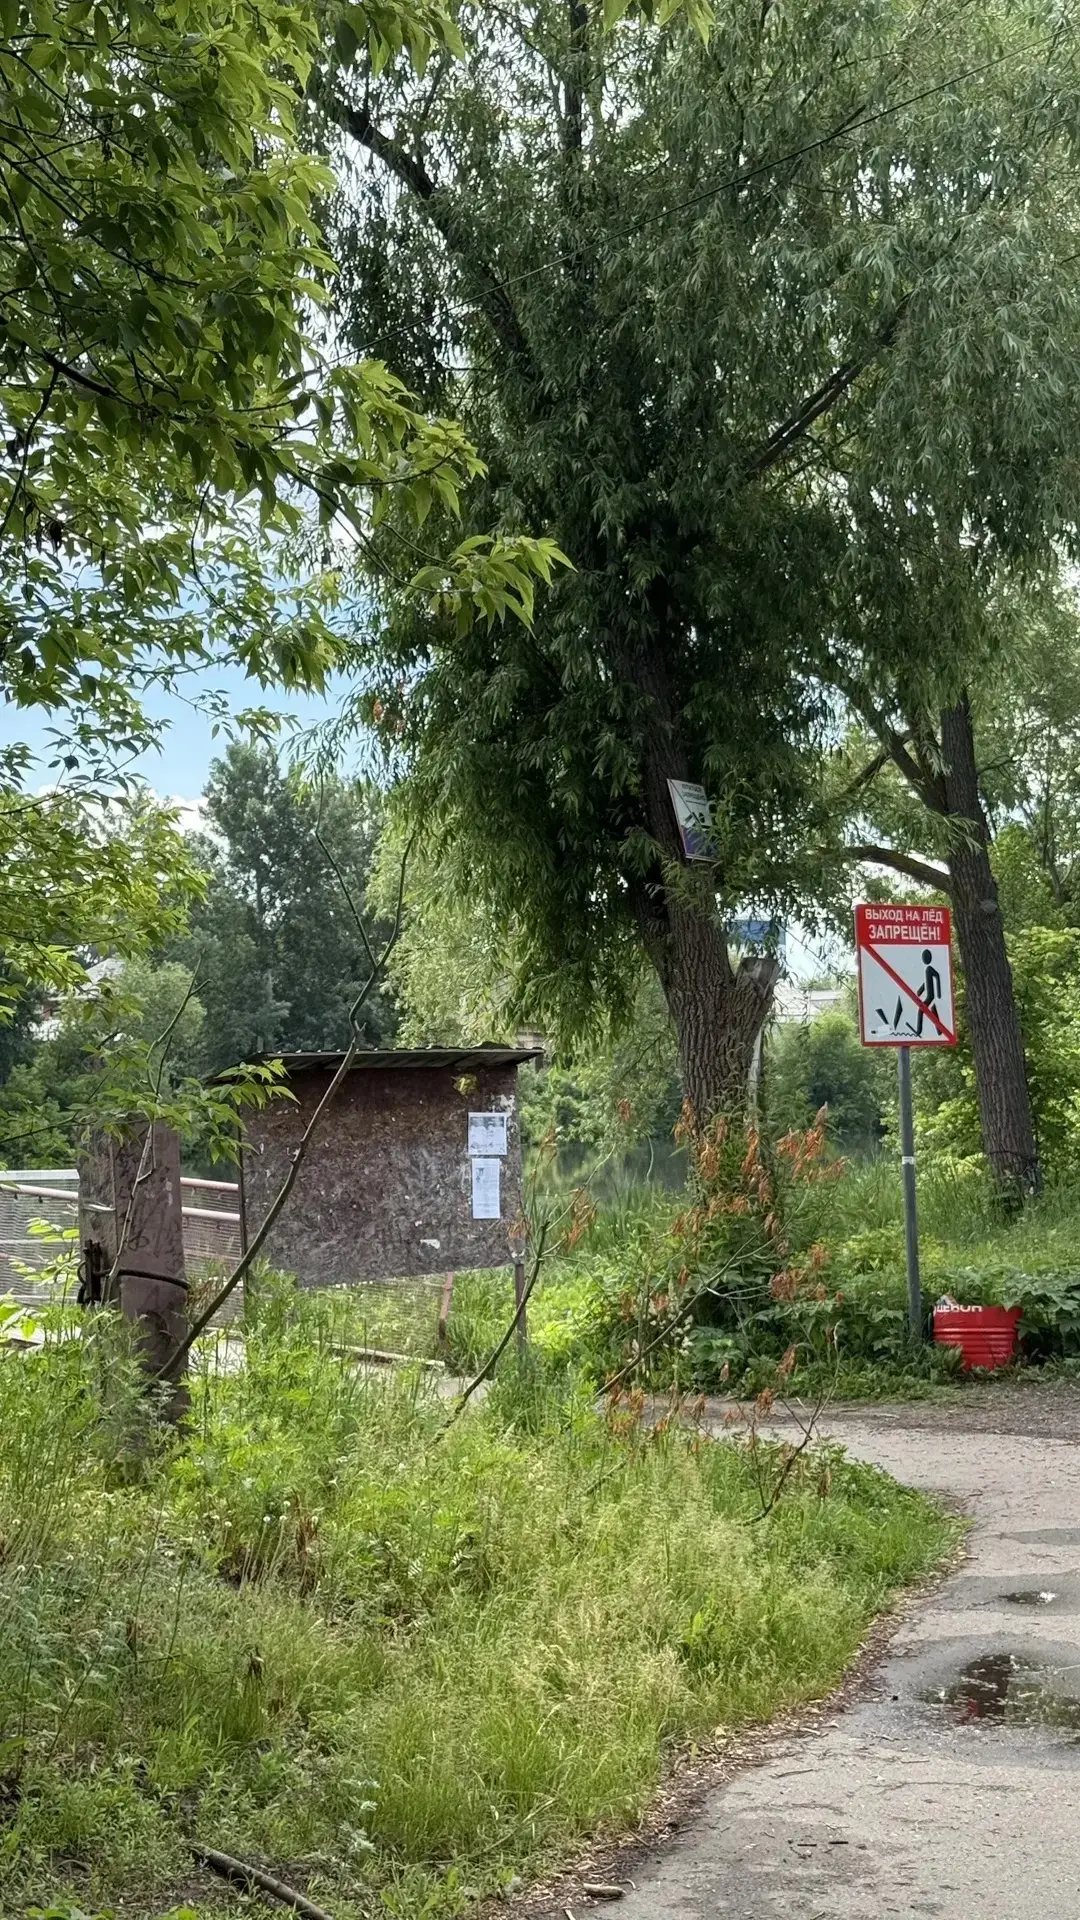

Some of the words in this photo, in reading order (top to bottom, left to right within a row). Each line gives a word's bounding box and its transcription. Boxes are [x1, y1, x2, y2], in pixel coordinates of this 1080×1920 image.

[865, 909, 903, 922] ВЫХОД
[906, 910, 920, 921] НА
[922, 909, 943, 923] ЛЁД
[868, 923, 941, 942] ЗАПРЕЩЁН!
